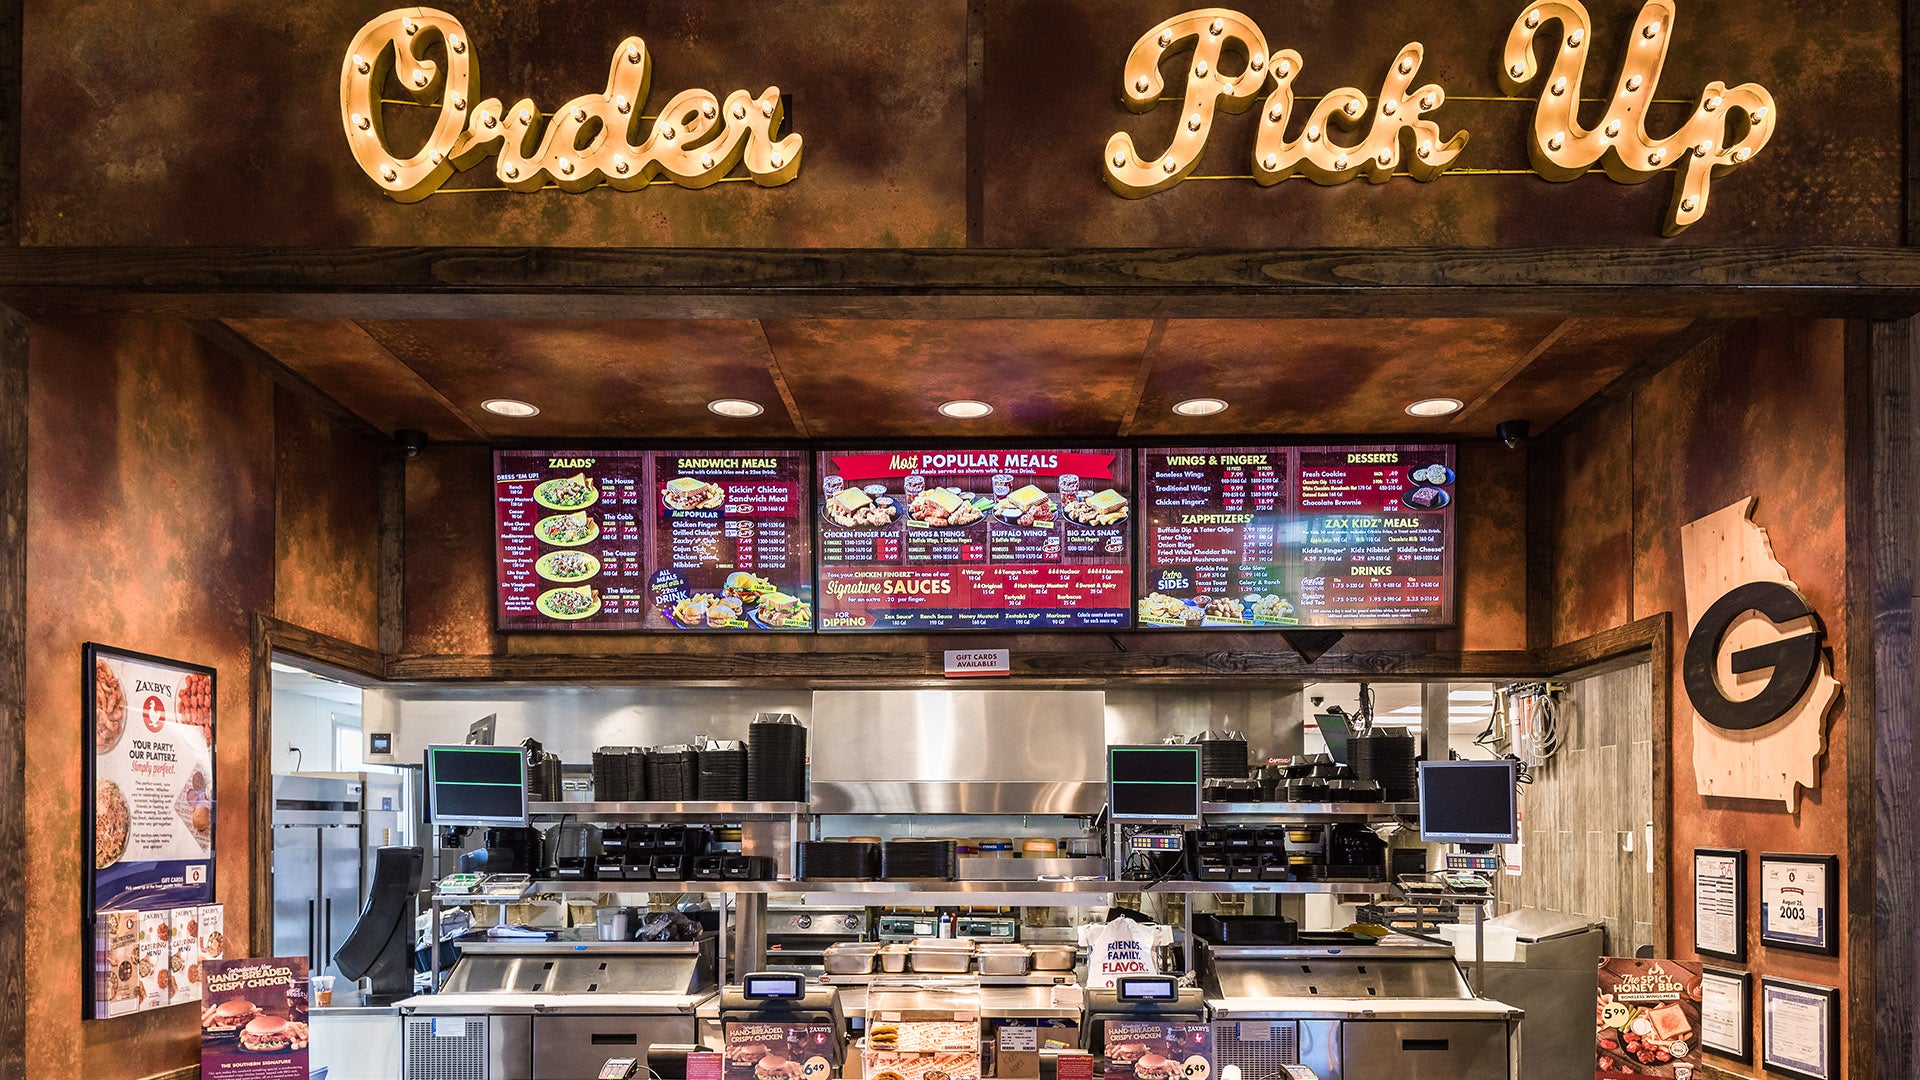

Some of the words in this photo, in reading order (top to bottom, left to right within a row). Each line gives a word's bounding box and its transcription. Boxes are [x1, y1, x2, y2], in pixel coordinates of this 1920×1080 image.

[341, 7, 803, 204] Order
[1105, 7, 1470, 198] Pick
[1501, 0, 1777, 237] Up
[678, 459, 738, 468] SANDWICH
[742, 459, 777, 468] MEALS
[889, 455, 918, 470] Most
[922, 454, 999, 468] POPULAR
[1005, 455, 1058, 468] MEALS
[1166, 456, 1205, 466] WINGS
[1209, 456, 1217, 465] &
[1221, 455, 1267, 465] FINGERZ
[1348, 454, 1398, 463] DESSERTS
[1325, 519, 1348, 528] ZAX
[1384, 519, 1419, 528] MEALS
[1162, 570, 1183, 580] Extra
[1351, 566, 1392, 576] DRINKS
[656, 575, 677, 583] MEALS
[1158, 579, 1189, 590] SIDES
[826, 581, 881, 600] Signature
[883, 580, 951, 594] SAUCES
[656, 590, 688, 604] DRINK
[823, 618, 866, 627] DIPPING
[1683, 581, 1822, 730] G
[136, 680, 172, 697] ZAXBY'S
[133, 740, 152, 749] YOUR
[129, 750, 144, 759] OUR
[146, 751, 177, 762] PLATTERZ.
[131, 761, 153, 776] Simply
[154, 762, 176, 778] perfect.
[1780, 906, 1805, 920] 2003
[141, 943, 166, 952] CATERING
[1108, 941, 1142, 951] FRIENDS.
[1108, 952, 1141, 960] FAMILY.
[1102, 962, 1149, 972] FLAVOR.
[207, 968, 292, 984] HAND-BREADED,
[1621, 974, 1641, 984] The
[1641, 975, 1673, 983] SPICY
[209, 981, 244, 992] CRISPY
[248, 976, 294, 988] CHICKEN
[1614, 983, 1655, 993] HONEY
[1658, 982, 1683, 992] BBQ
